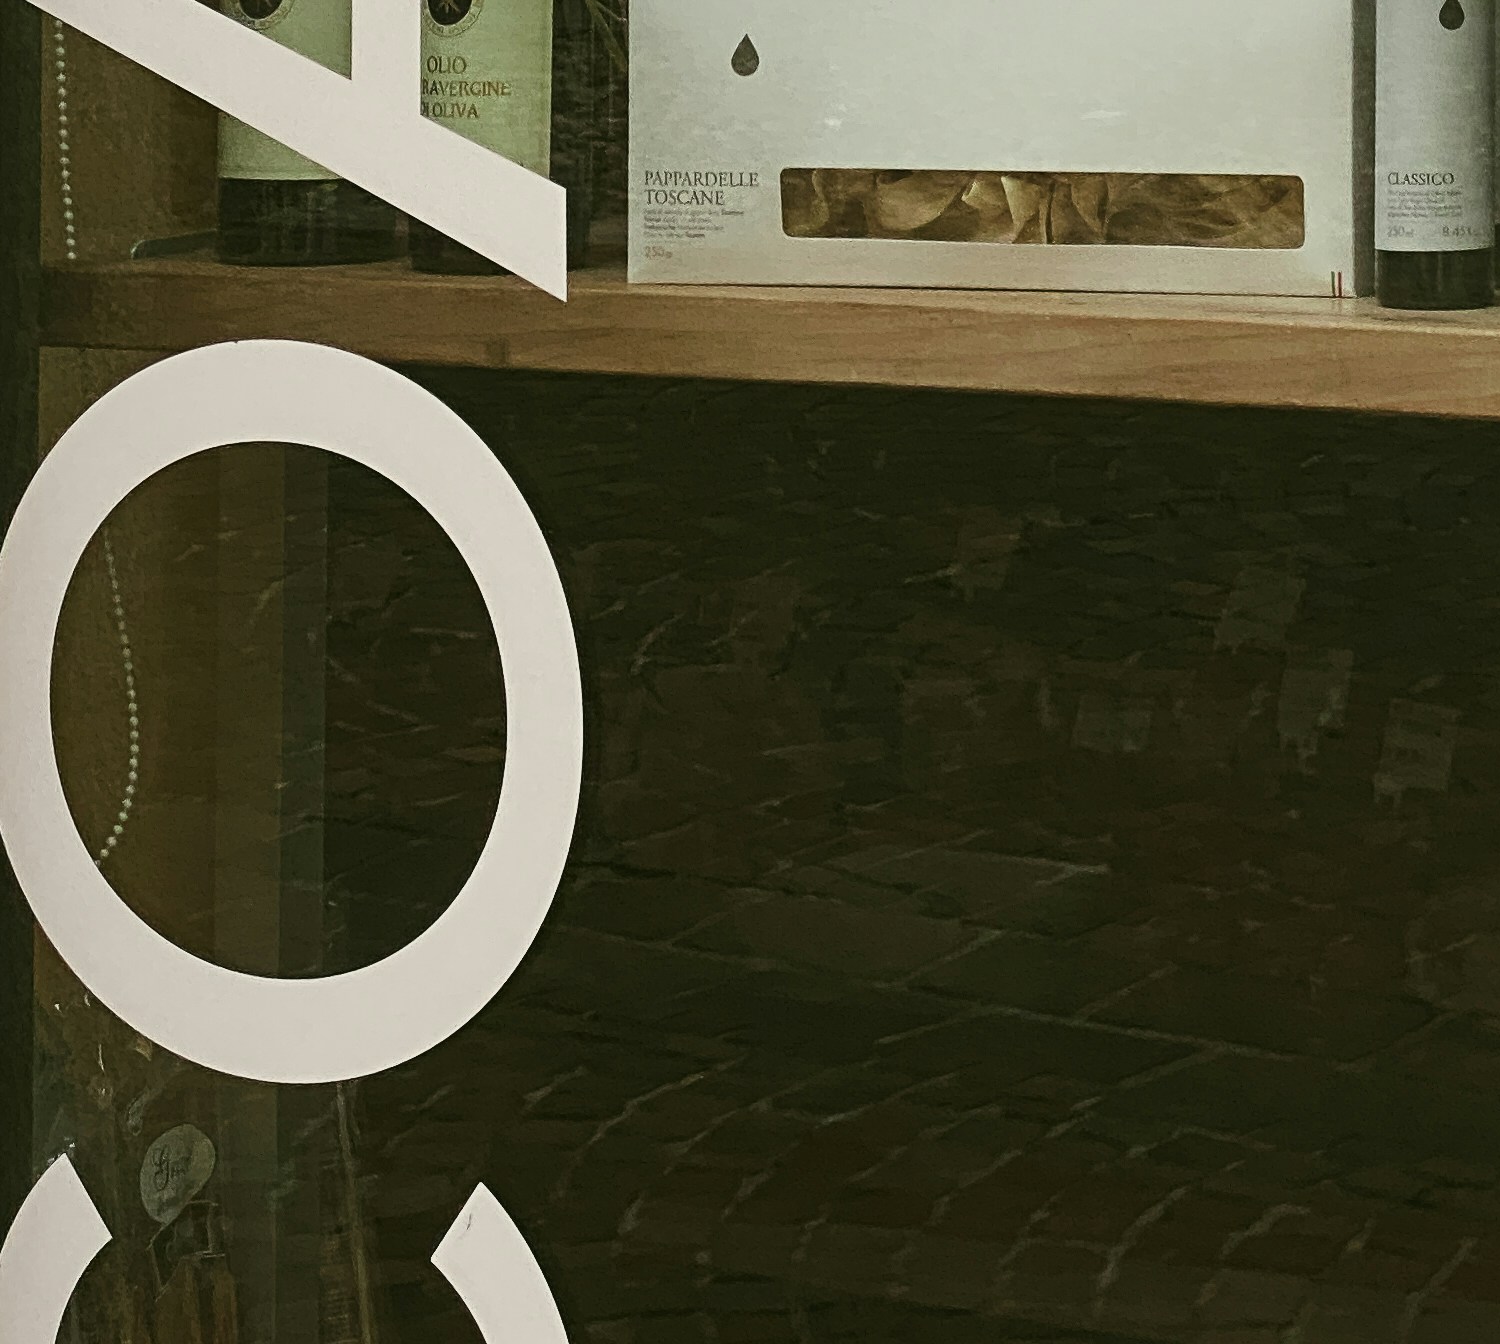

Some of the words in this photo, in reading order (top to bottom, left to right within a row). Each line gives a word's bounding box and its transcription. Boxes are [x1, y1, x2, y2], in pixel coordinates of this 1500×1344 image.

[426, 55, 467, 74] OLIO
[432, 102, 479, 118] OLIVA
[644, 170, 760, 187] PAPPARDELLE
[1387, 171, 1455, 186] CLASSICO
[643, 189, 725, 206] TOSCANE
